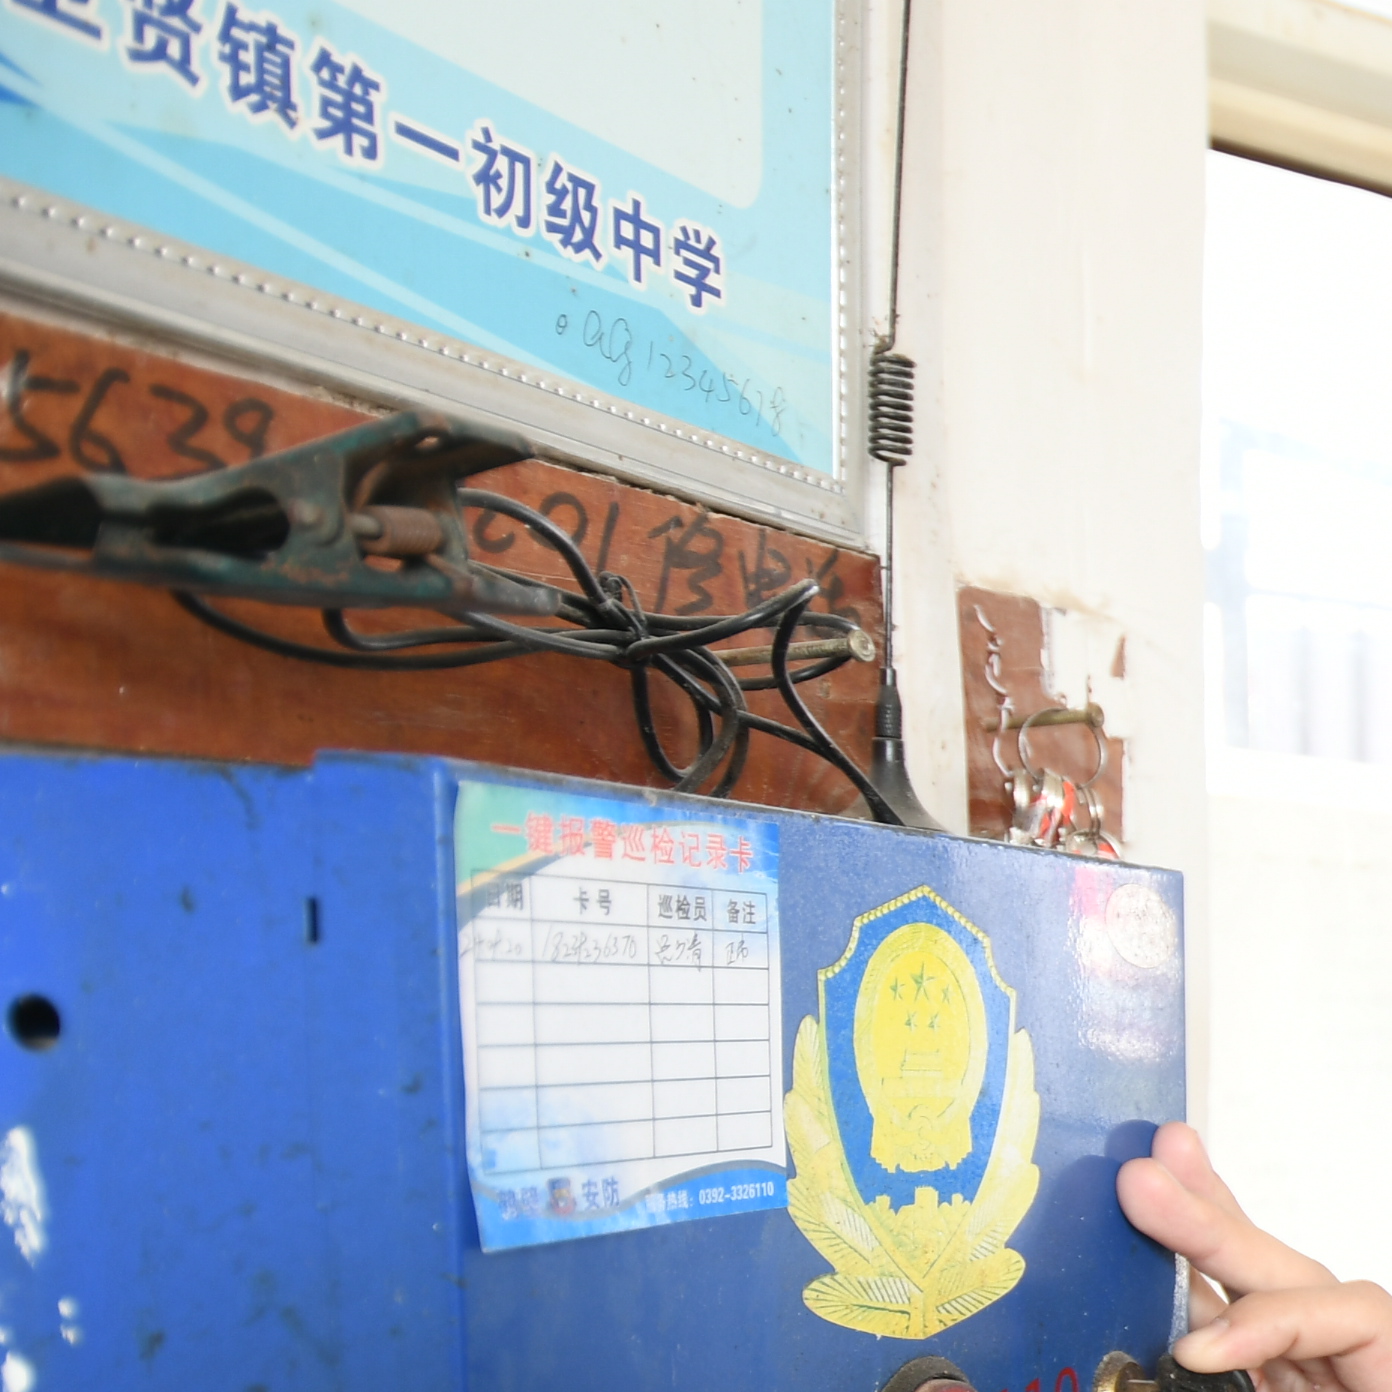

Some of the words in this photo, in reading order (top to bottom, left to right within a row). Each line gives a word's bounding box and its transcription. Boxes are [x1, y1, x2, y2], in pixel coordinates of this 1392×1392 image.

[491, 810, 754, 874] 一键报警巡检记录卡
[573, 887, 612, 916] 卡号
[657, 893, 708, 923] 巡检员
[726, 900, 757, 925] 备注
